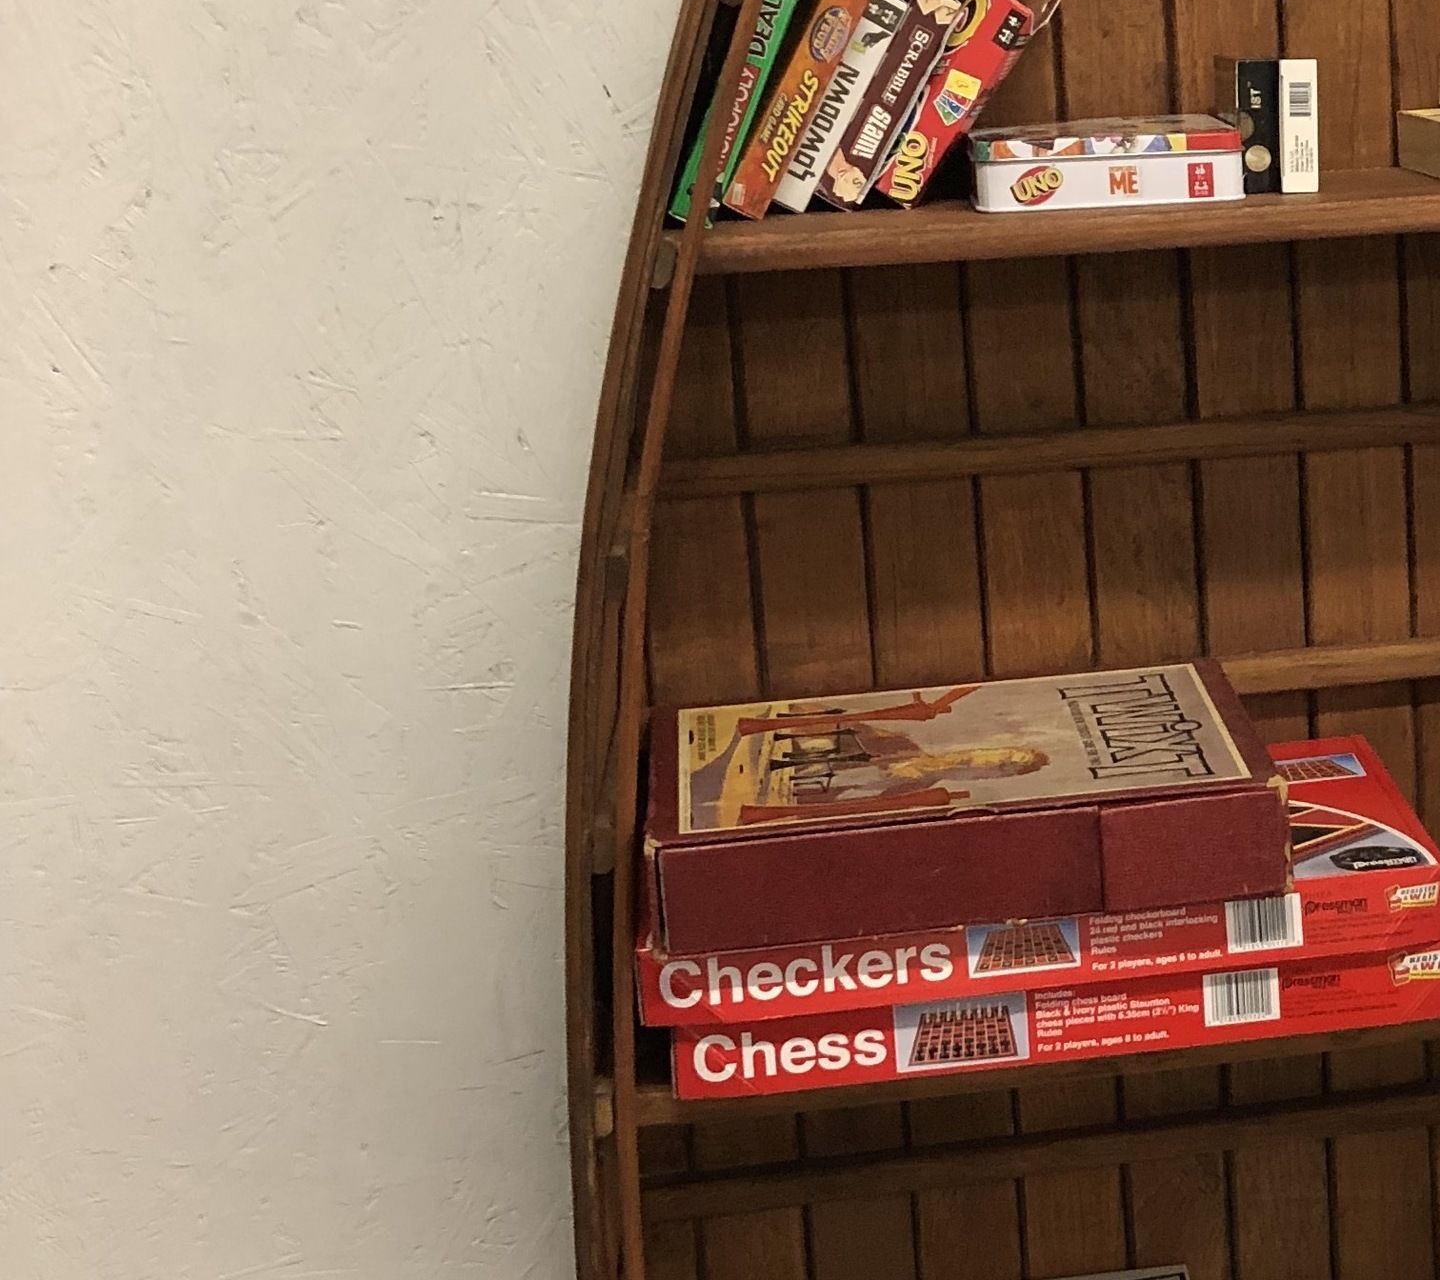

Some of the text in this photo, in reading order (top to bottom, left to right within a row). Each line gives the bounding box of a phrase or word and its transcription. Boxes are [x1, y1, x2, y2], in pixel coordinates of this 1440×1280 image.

[882, 29, 931, 107] SCRABBLE
[761, 69, 820, 183] STRIKEOUT
[788, 60, 860, 182] LOWDOWN
[889, 131, 929, 201] UNO
[1109, 171, 1139, 195] ME
[1010, 167, 1064, 204] UNO
[1056, 673, 1215, 780] TWIXT
[1090, 930, 1163, 946] plastic checkers
[659, 940, 953, 1010] Checkers
[1092, 962, 1108, 971] For
[1155, 955, 1177, 966] ages
[1187, 952, 1197, 960] to
[1035, 1009, 1061, 1020] Black
[1073, 1006, 1096, 1017] ivory
[1097, 1002, 1128, 1013] plastic
[1036, 1018, 1063, 1029] chess
[1065, 1015, 1095, 1027] pieces
[1097, 1012, 1116, 1022] with
[1178, 1003, 1200, 1014] King
[1101, 992, 1127, 1003] board
[693, 1027, 888, 1083] Chess
[1037, 1043, 1053, 1052] For
[1063, 1038, 1099, 1051] players,
[1100, 1035, 1123, 1047] ages
[1133, 1032, 1143, 1041] to
